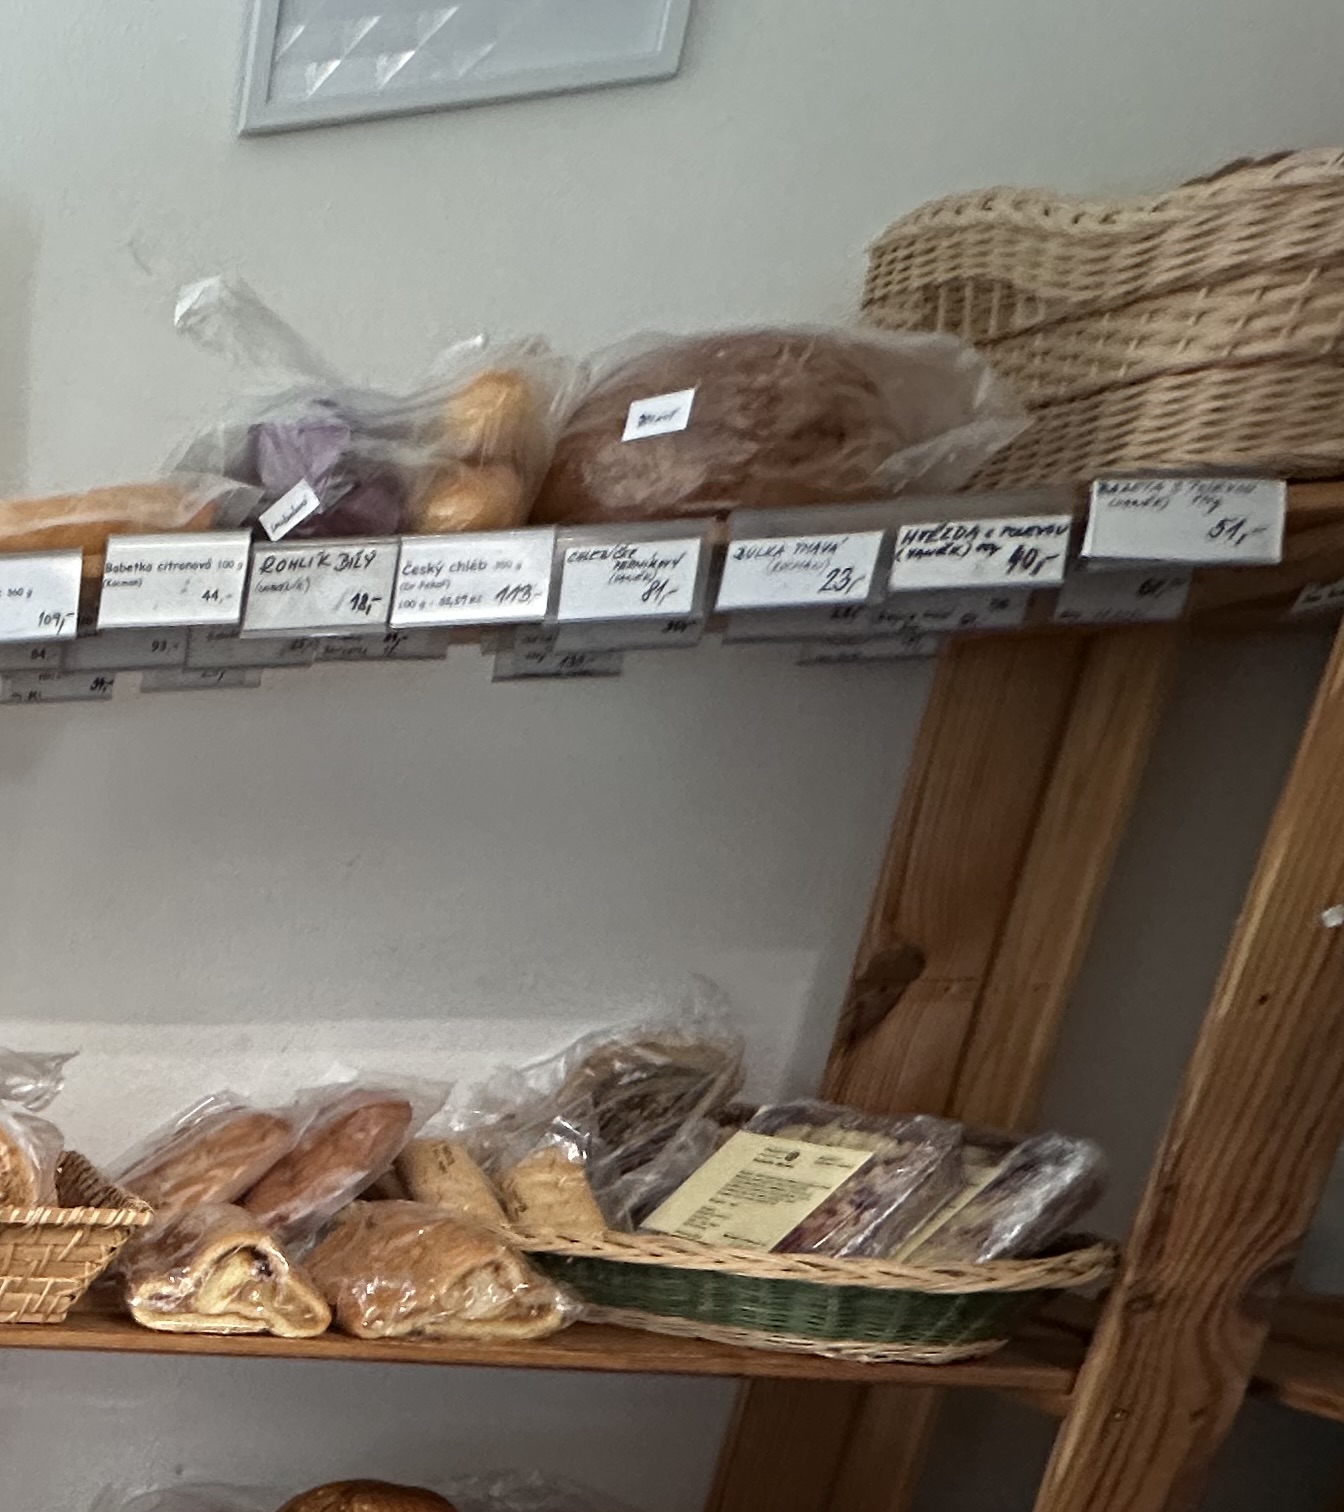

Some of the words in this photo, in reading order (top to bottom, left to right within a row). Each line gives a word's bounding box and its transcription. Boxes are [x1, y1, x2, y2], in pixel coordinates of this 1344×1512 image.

[259, 550, 331, 575] ROHLÍK
[401, 560, 445, 578] Český
[448, 557, 488, 573] chléb
[200, 588, 233, 604] 44,-
